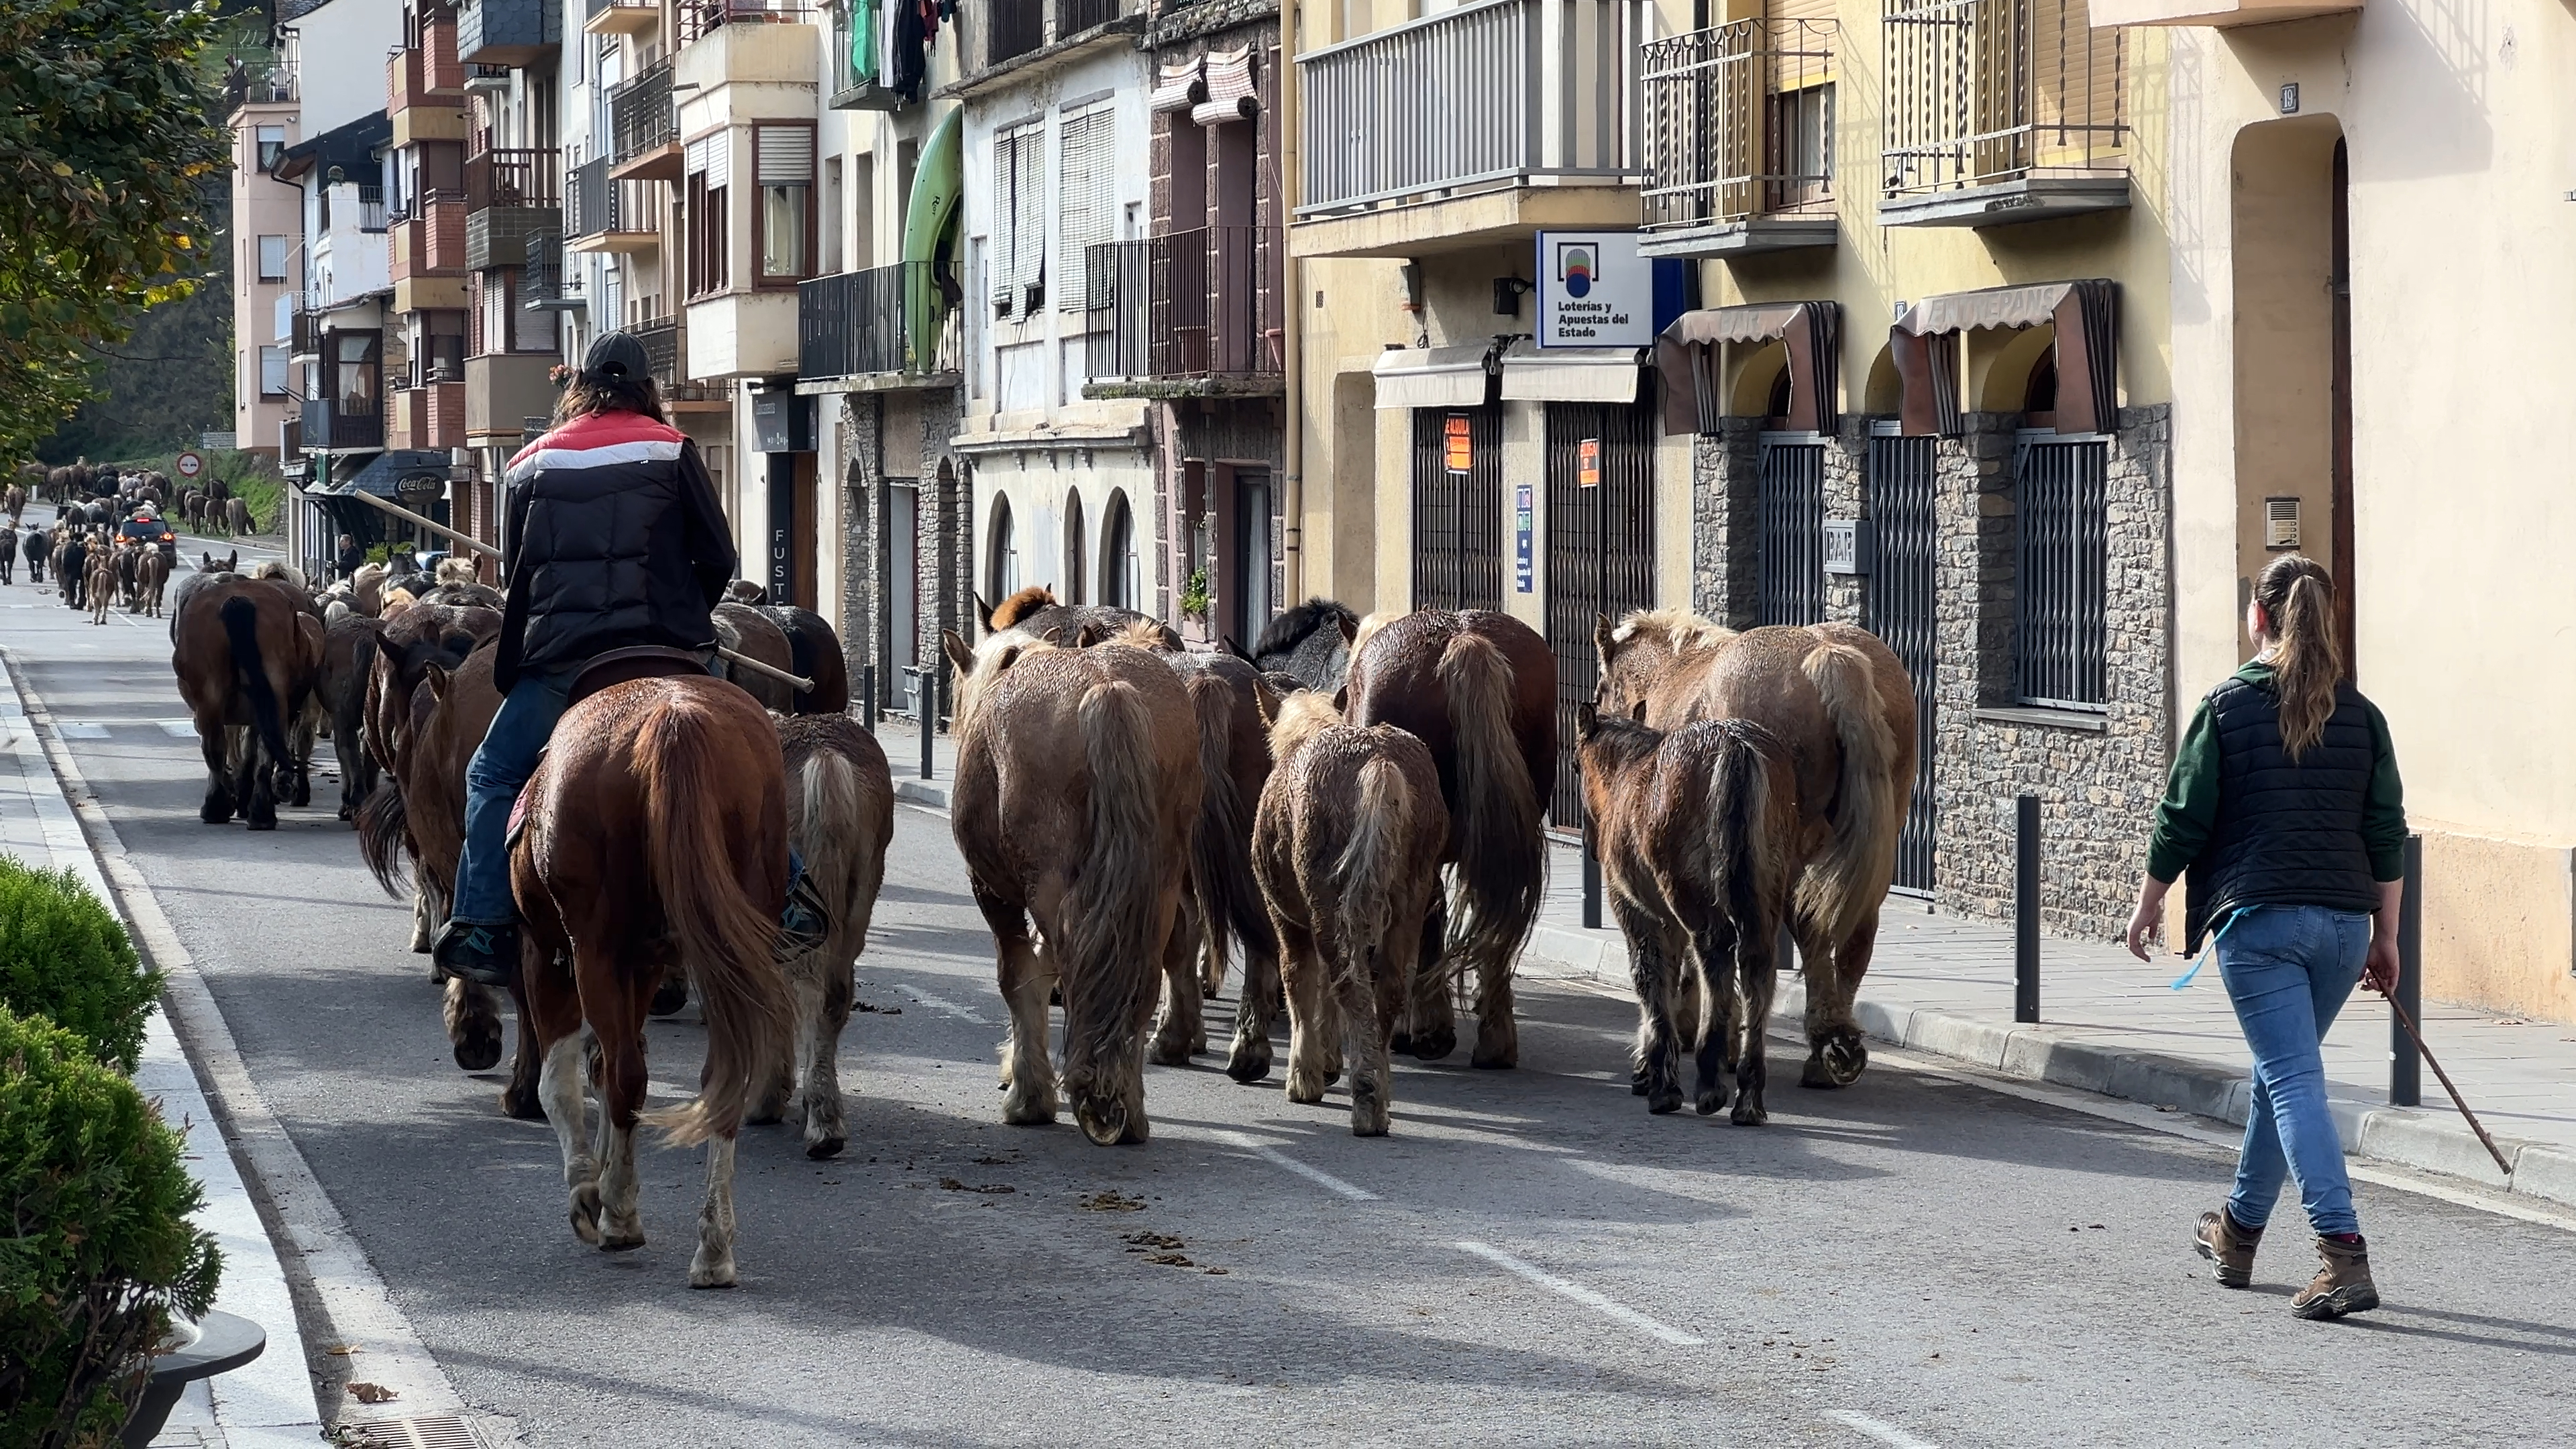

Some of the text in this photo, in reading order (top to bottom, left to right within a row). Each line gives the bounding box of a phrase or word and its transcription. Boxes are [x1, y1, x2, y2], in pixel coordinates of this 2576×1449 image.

[2284, 89, 2293, 107] 19
[1558, 301, 1611, 313] Loterías y
[1897, 304, 1904, 321] 18
[1558, 313, 1628, 326] Apuestas del
[1558, 327, 1596, 337] Estado
